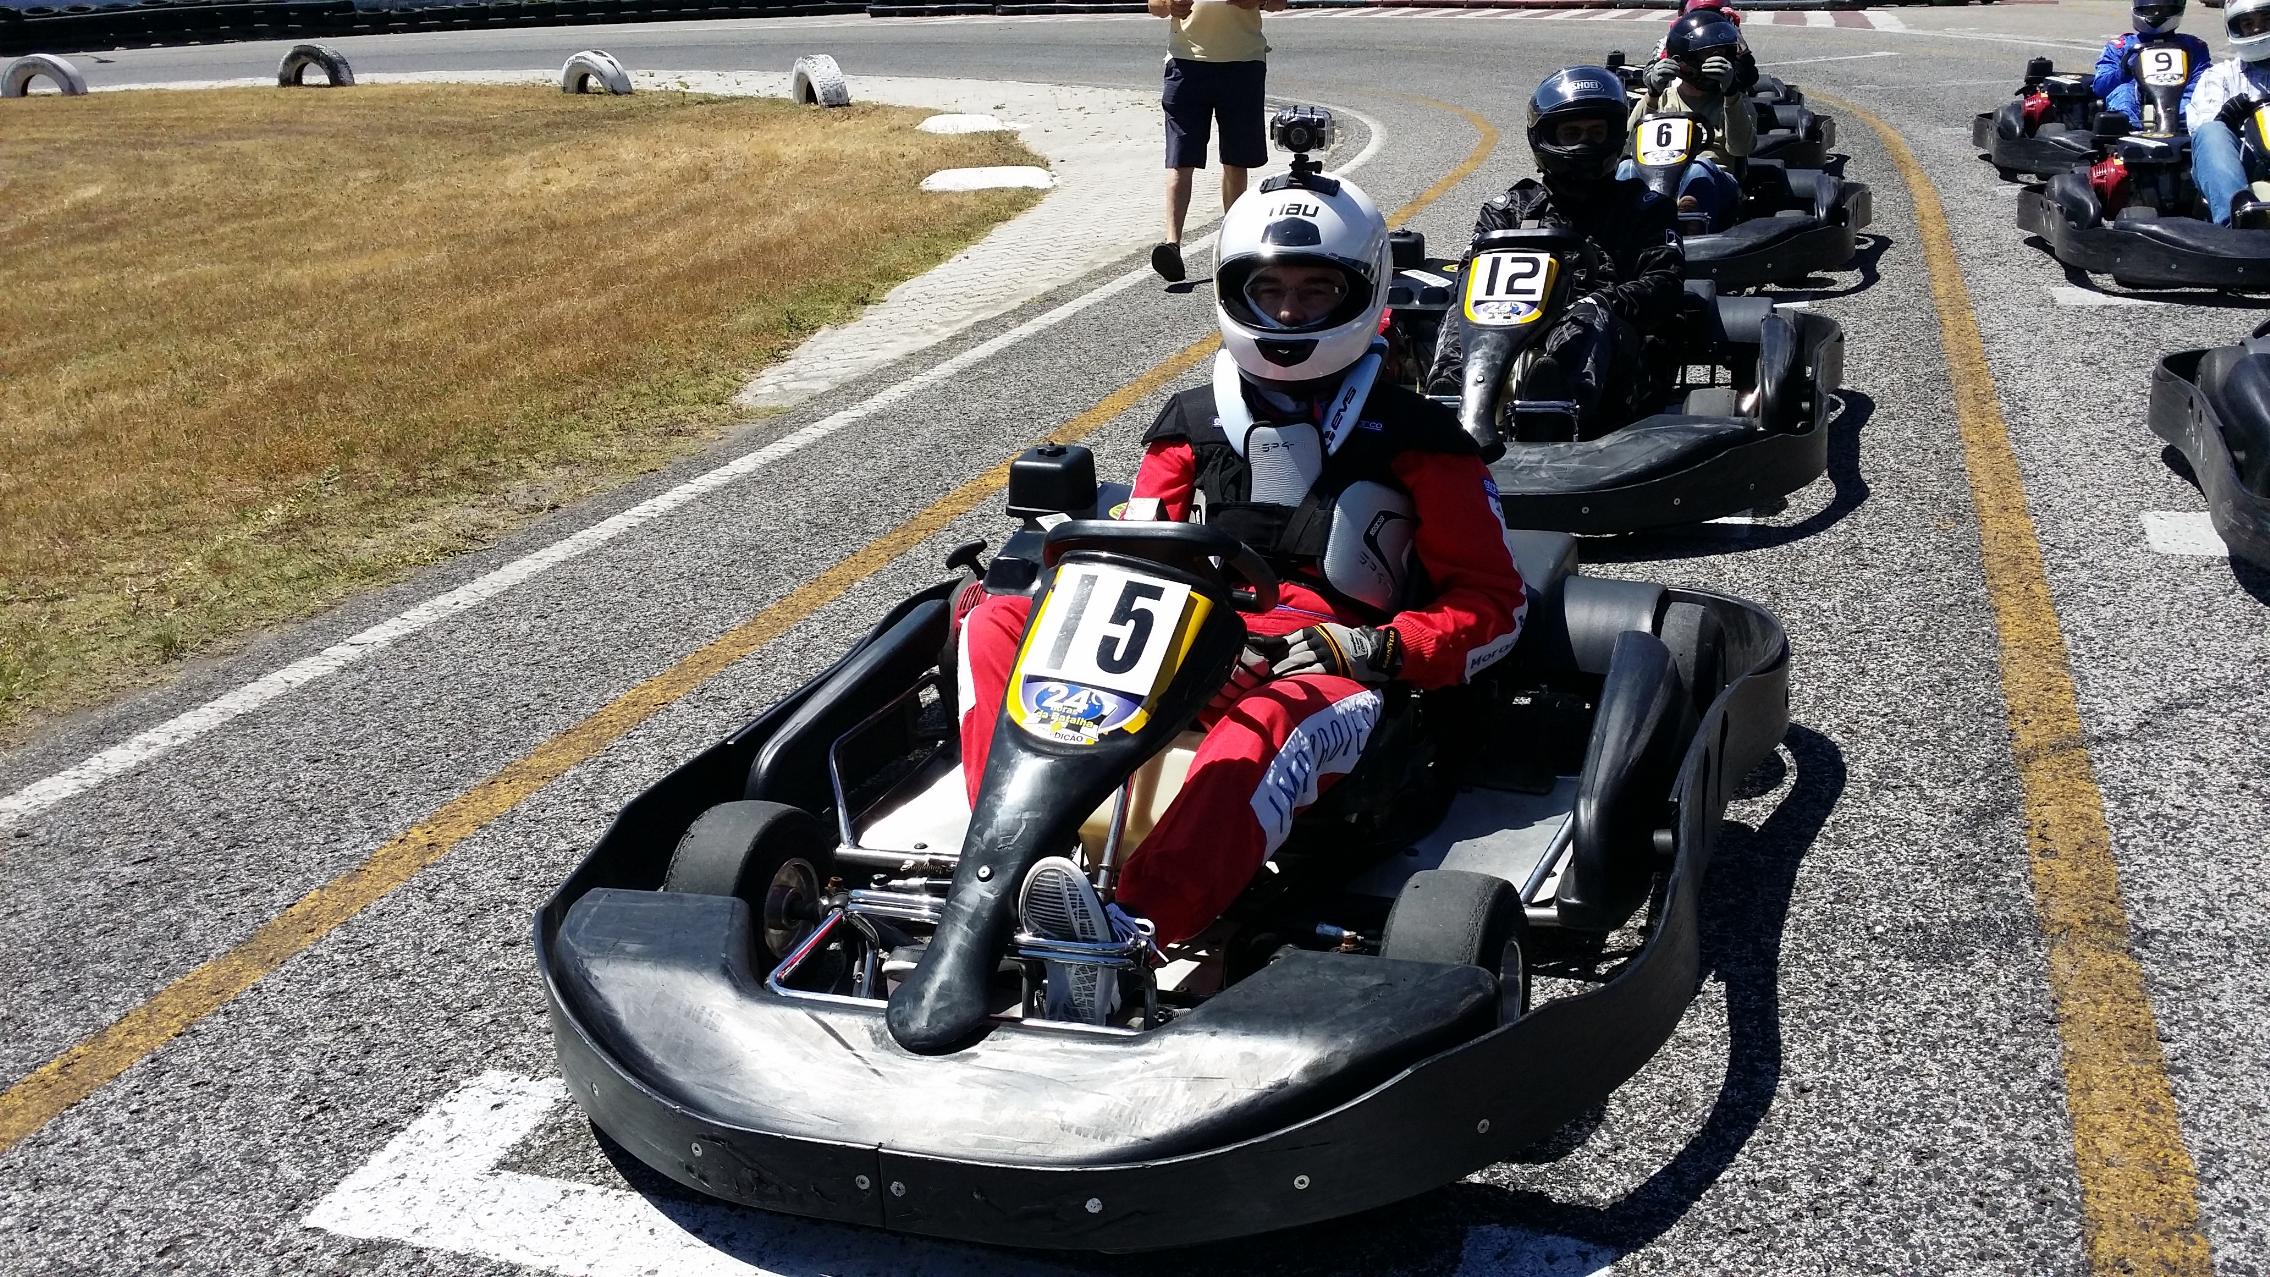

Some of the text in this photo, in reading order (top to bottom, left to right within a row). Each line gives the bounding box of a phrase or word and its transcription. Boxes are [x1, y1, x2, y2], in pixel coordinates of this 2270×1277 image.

[2154, 52, 2172, 72] 9
[1571, 80, 1599, 90] SHOEI
[1656, 122, 1672, 147] 6
[1485, 256, 1540, 296] 12
[1046, 573, 1165, 674] 15
[1041, 684, 1092, 713] 24
